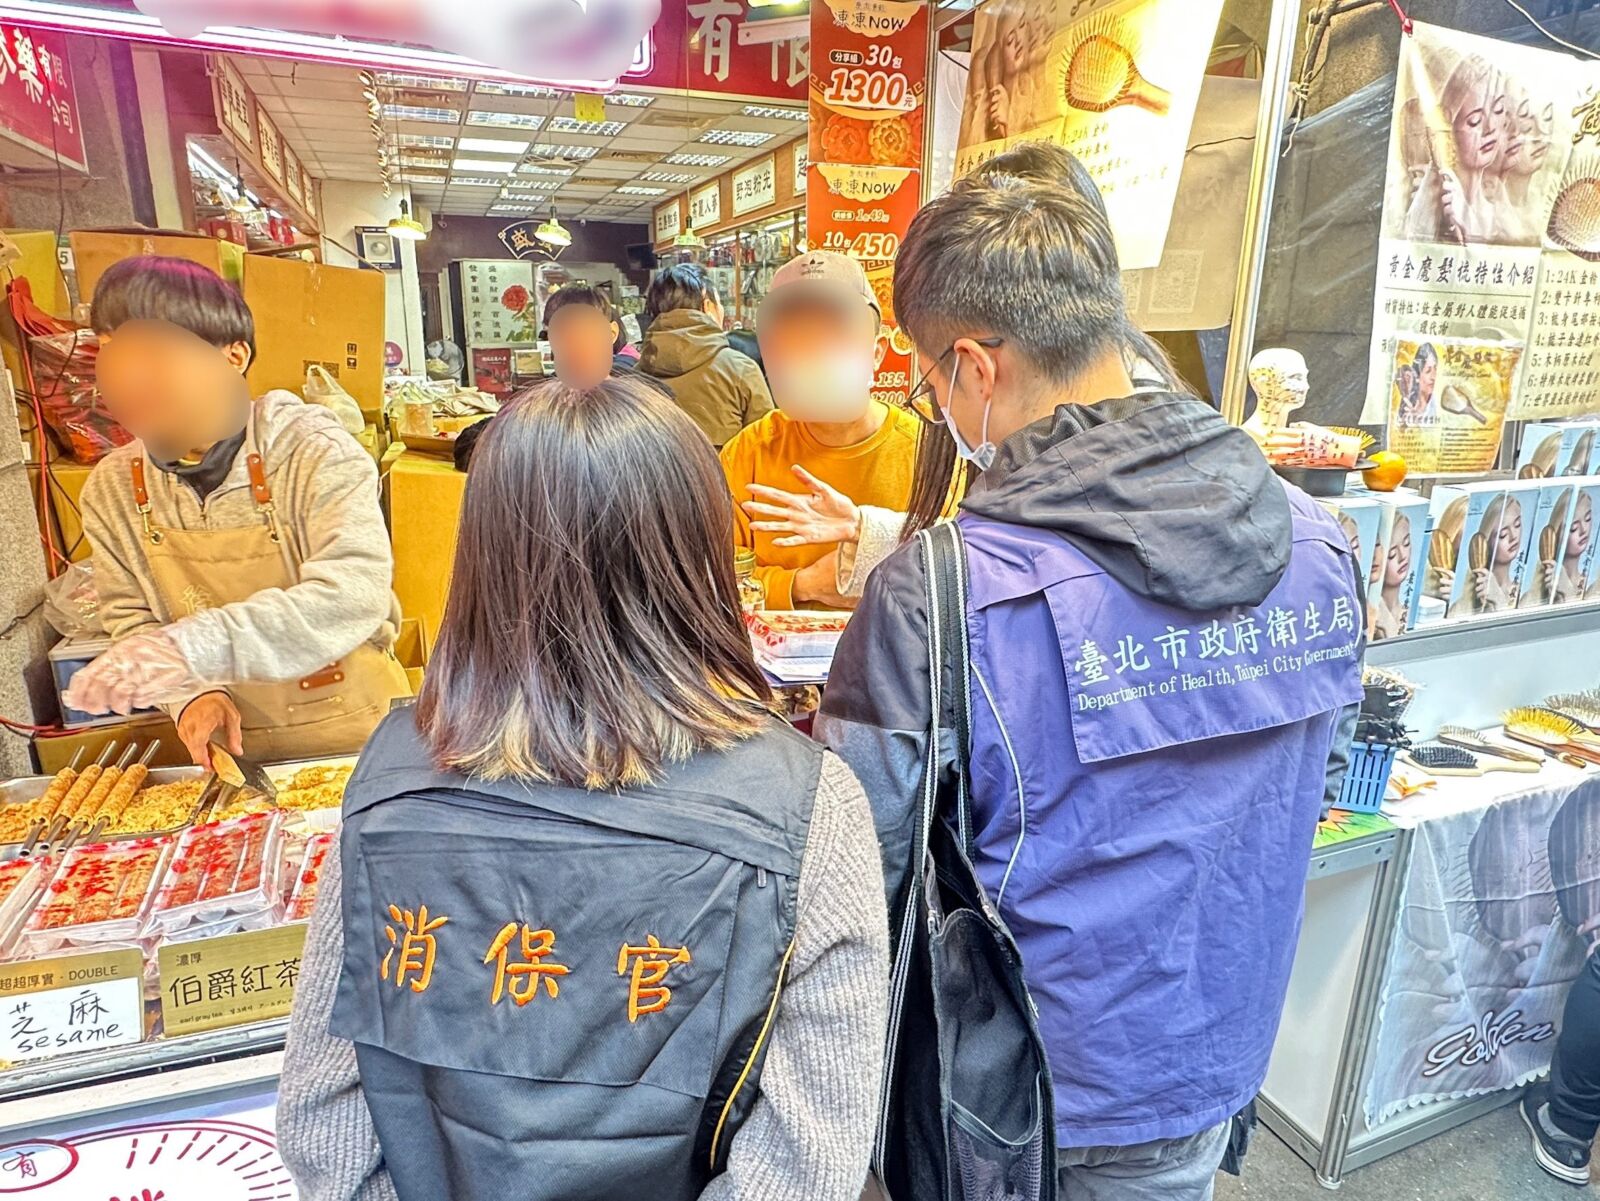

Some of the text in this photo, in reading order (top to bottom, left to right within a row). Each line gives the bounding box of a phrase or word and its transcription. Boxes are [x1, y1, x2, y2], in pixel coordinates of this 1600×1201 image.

[1074, 596, 1355, 688] 臺北市政府衛生局
[1078, 678, 1156, 711] Department
[1160, 677, 1178, 694] of
[1273, 655, 1303, 673] City
[1304, 643, 1356, 667] Government
[69, 965, 119, 981] DOUBLE
[170, 958, 302, 1008] 伯爵紅茶
[176, 952, 202, 967] 濃厚
[380, 904, 691, 1023] 消保官
[9, 989, 110, 1039] 芝麻
[17, 1023, 124, 1053] sesame
